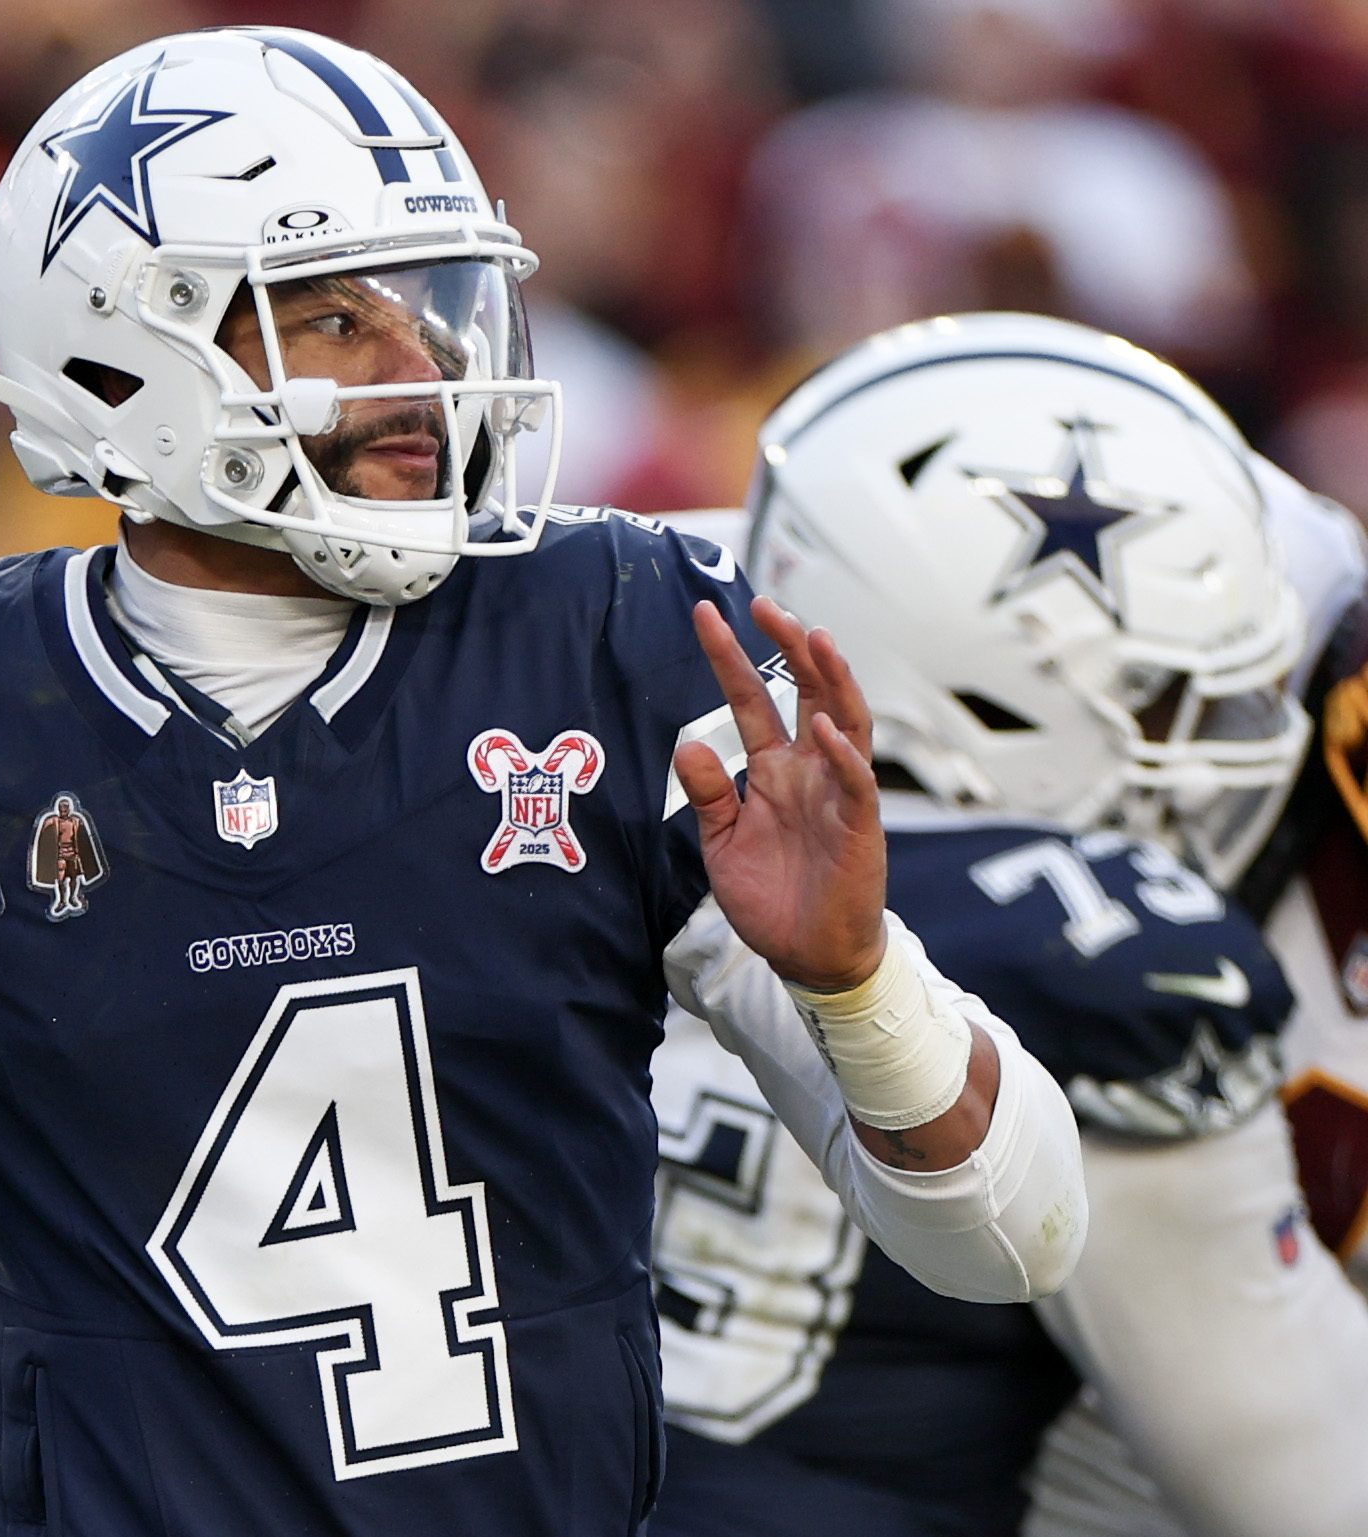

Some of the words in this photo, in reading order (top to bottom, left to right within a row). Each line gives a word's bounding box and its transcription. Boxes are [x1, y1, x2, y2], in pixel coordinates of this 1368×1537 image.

[404, 195, 478, 213] COWBOYS
[226, 804, 268, 833] NFL
[513, 796, 558, 828] NFL
[519, 843, 551, 855] 2025
[967, 830, 1226, 959] 73
[188, 923, 356, 973] COWBOYS
[144, 966, 520, 1482] 4
